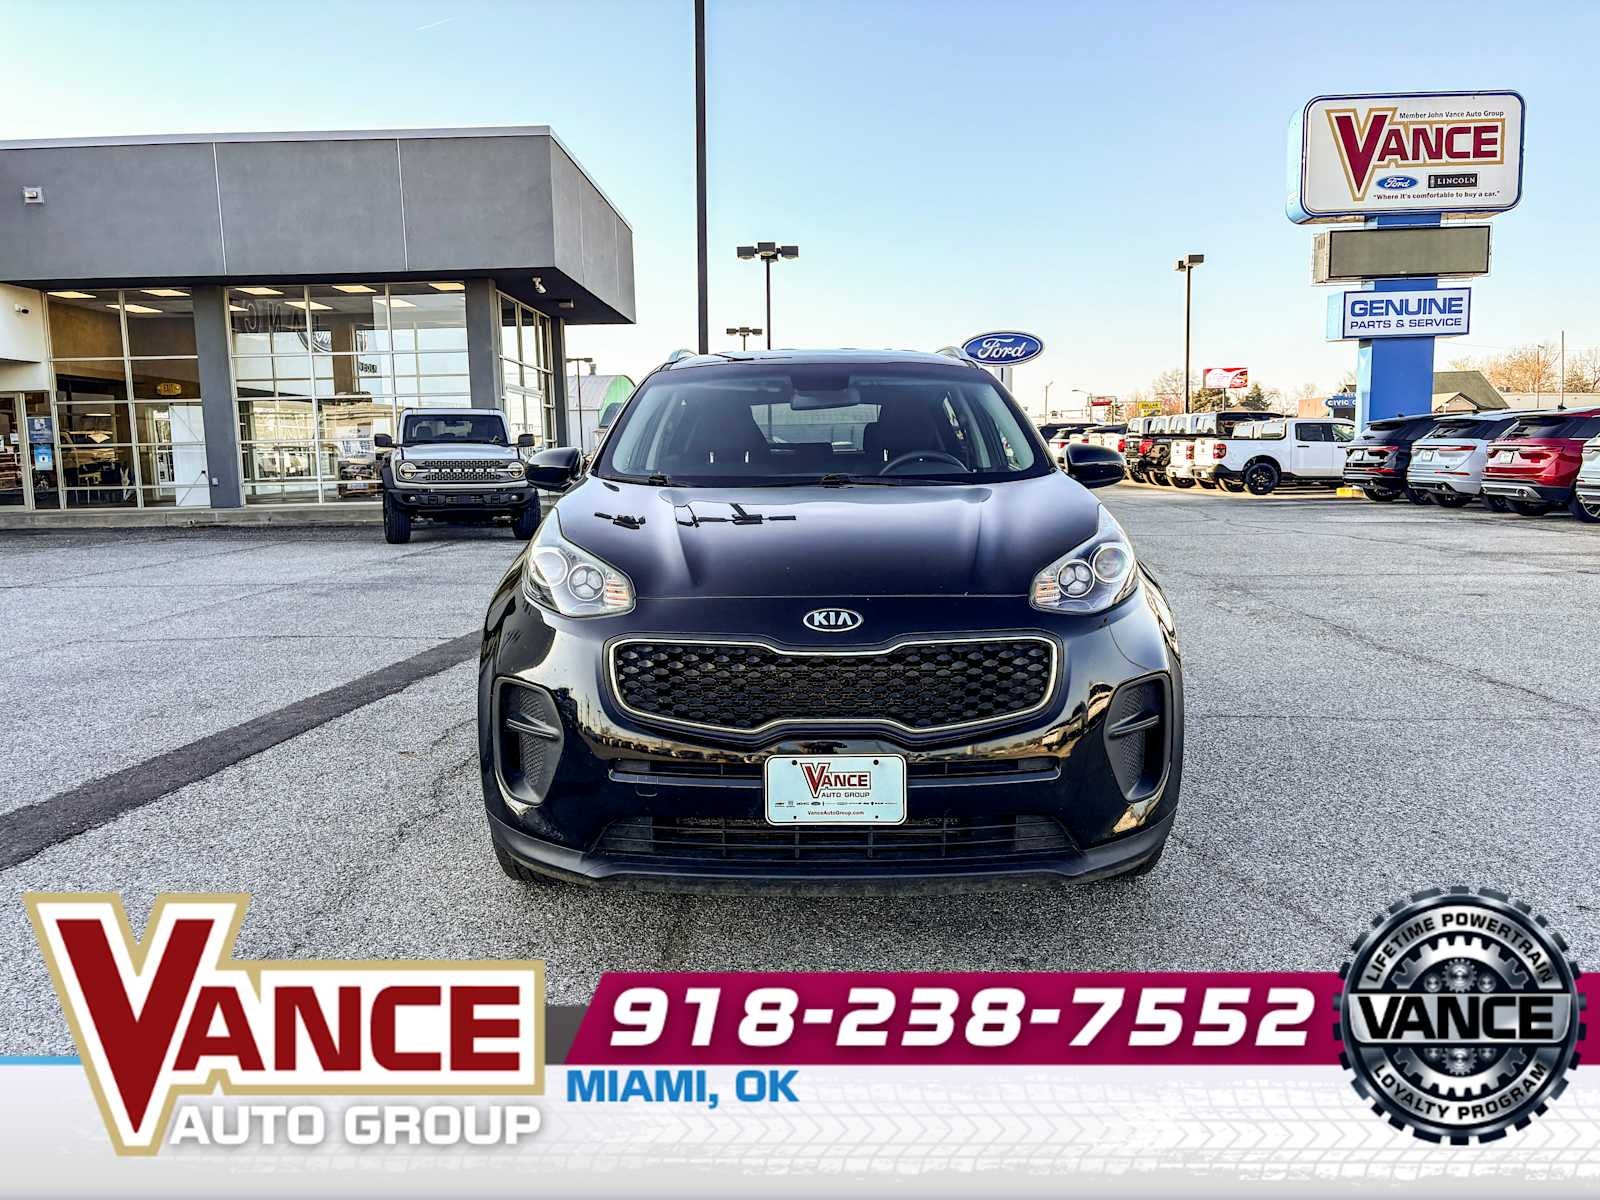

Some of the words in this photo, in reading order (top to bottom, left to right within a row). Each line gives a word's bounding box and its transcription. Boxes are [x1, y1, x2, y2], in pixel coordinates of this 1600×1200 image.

[1399, 112, 1426, 120] Member
[1427, 111, 1444, 119] John
[1445, 111, 1464, 119] Vance
[1465, 110, 1482, 118] Auto
[1483, 110, 1504, 119] Group
[1334, 114, 1499, 193] VANCE
[1382, 176, 1413, 189] Ford
[1437, 176, 1476, 186] LINCOLN
[1412, 191, 1454, 200] comfortable
[1464, 190, 1478, 200] buy
[1350, 297, 1463, 317] GENUINE
[1350, 319, 1391, 331] PARTS
[1396, 319, 1405, 329] &
[1409, 317, 1462, 328] SERVICE
[977, 336, 1026, 360] Ford
[813, 611, 854, 627] KIA
[804, 765, 869, 796] VANCE
